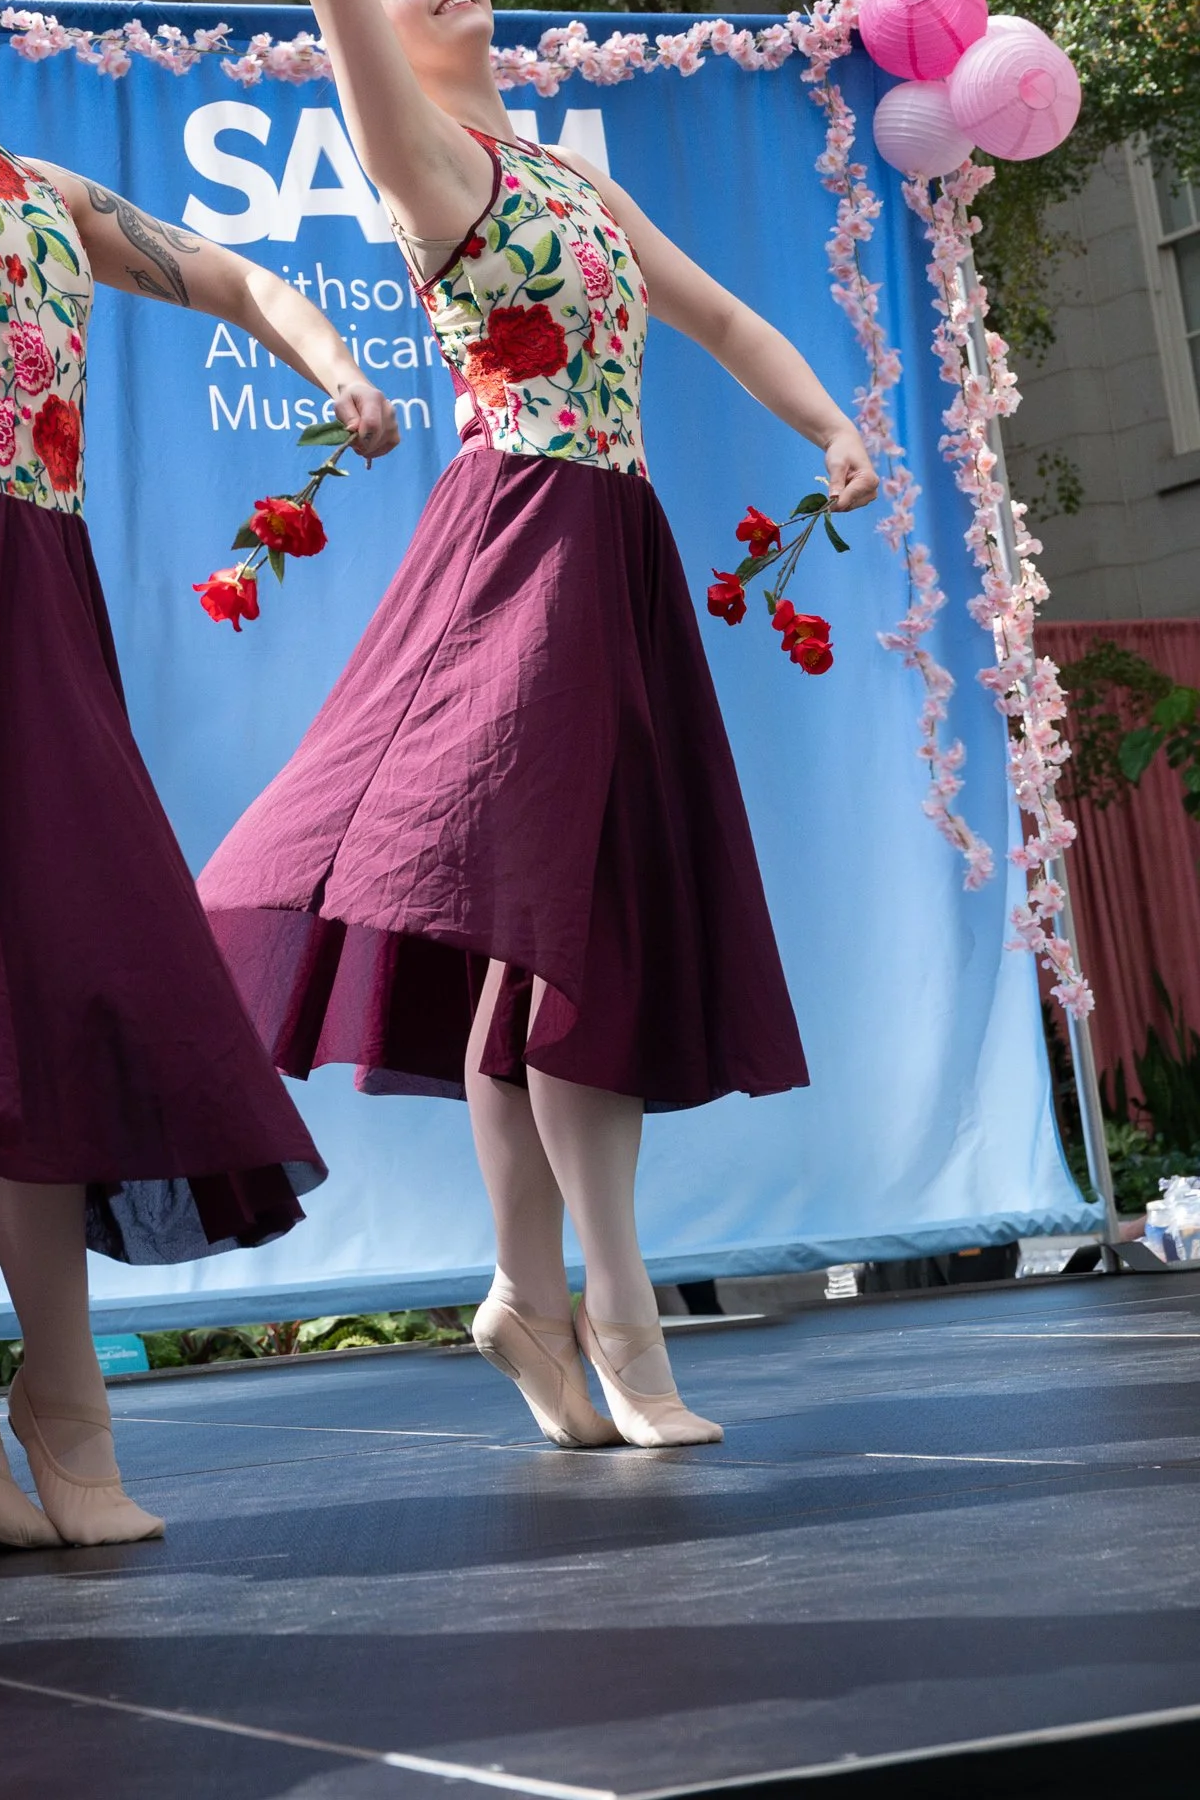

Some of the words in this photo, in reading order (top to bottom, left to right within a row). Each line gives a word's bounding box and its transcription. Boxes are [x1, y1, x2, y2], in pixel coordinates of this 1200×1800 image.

[181, 100, 611, 244] SA
[204, 322, 450, 369] Aican
[208, 383, 431, 431] Musem
